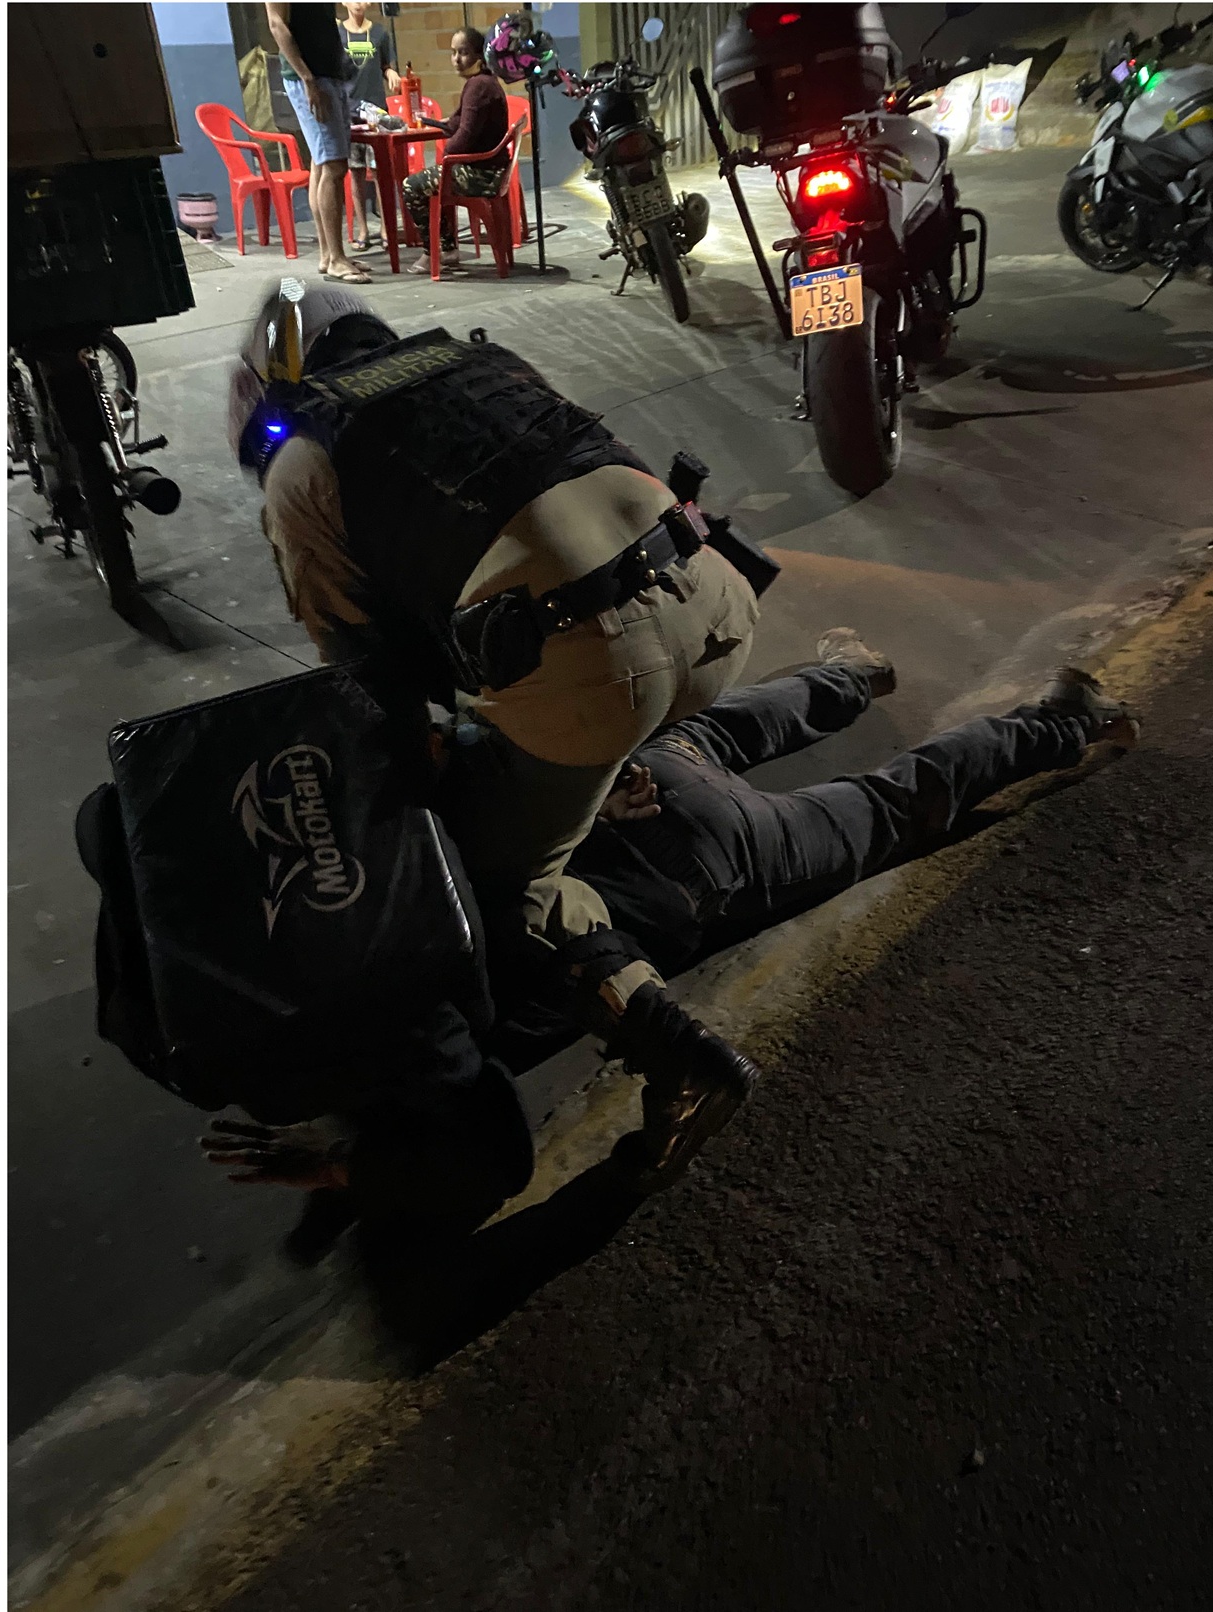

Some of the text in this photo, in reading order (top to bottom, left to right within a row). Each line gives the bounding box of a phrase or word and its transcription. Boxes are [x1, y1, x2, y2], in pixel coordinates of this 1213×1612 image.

[812, 273, 840, 284] BRASIL
[806, 281, 846, 307] TBJ
[351, 351, 463, 398] MILITAR
